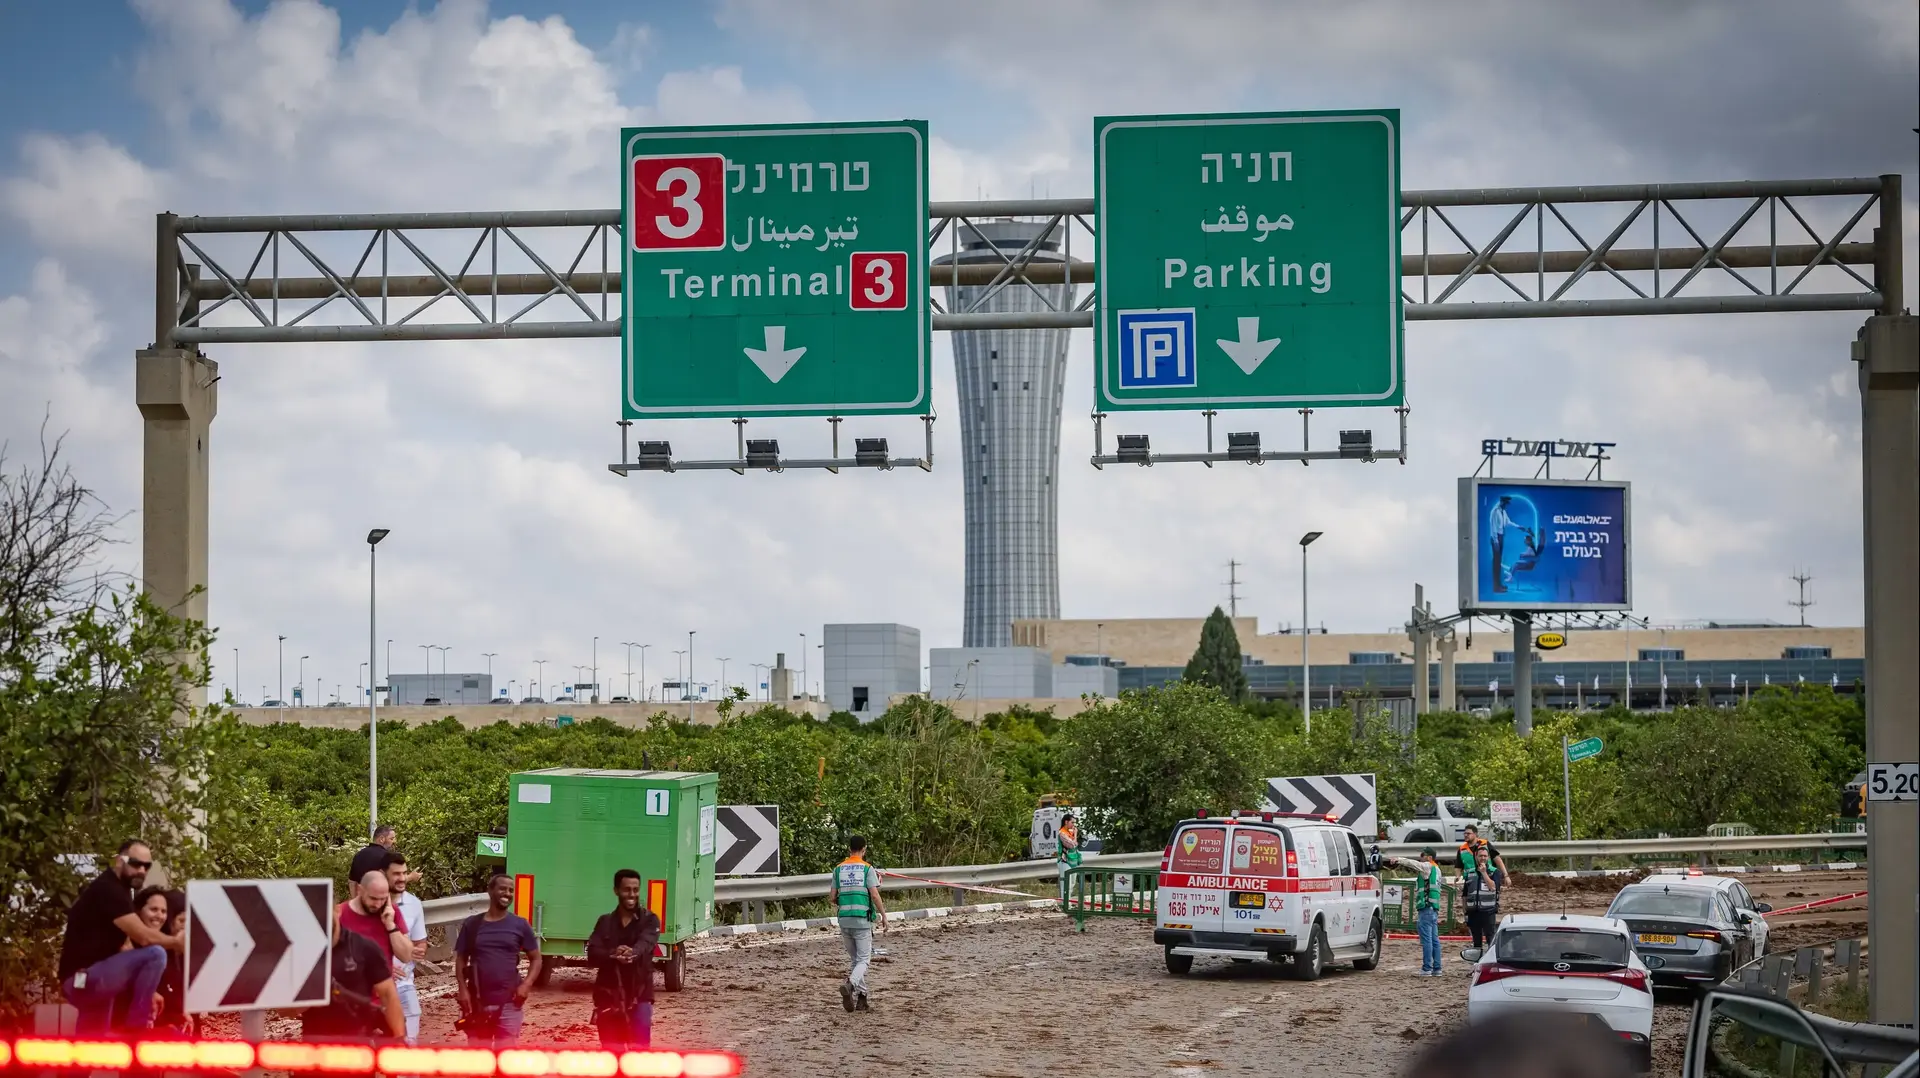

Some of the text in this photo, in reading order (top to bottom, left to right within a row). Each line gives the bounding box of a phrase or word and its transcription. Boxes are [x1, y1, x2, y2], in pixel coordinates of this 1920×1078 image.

[726, 159, 870, 193] טרמינל
[1201, 151, 1293, 183] חניה
[655, 167, 704, 239] 3
[1201, 205, 1294, 242] موقف
[731, 215, 860, 252] تيرمينال
[660, 258, 894, 303] Terminal 3
[1164, 256, 1332, 294] Parking
[1554, 531, 1610, 544] הכי בבית
[1562, 544, 1602, 558] בעולם
[1871, 768, 1919, 795] 5.20
[654, 792, 661, 813] 1
[1038, 842, 1057, 850] TOYOTA
[1252, 843, 1278, 855] מציל
[1252, 855, 1277, 866] חיים
[1187, 875, 1269, 891] AMBULANCE
[1171, 892, 1216, 903] מגן דוד אדום
[1168, 901, 1220, 917] איילון 1636
[1234, 909, 1252, 920] 101
